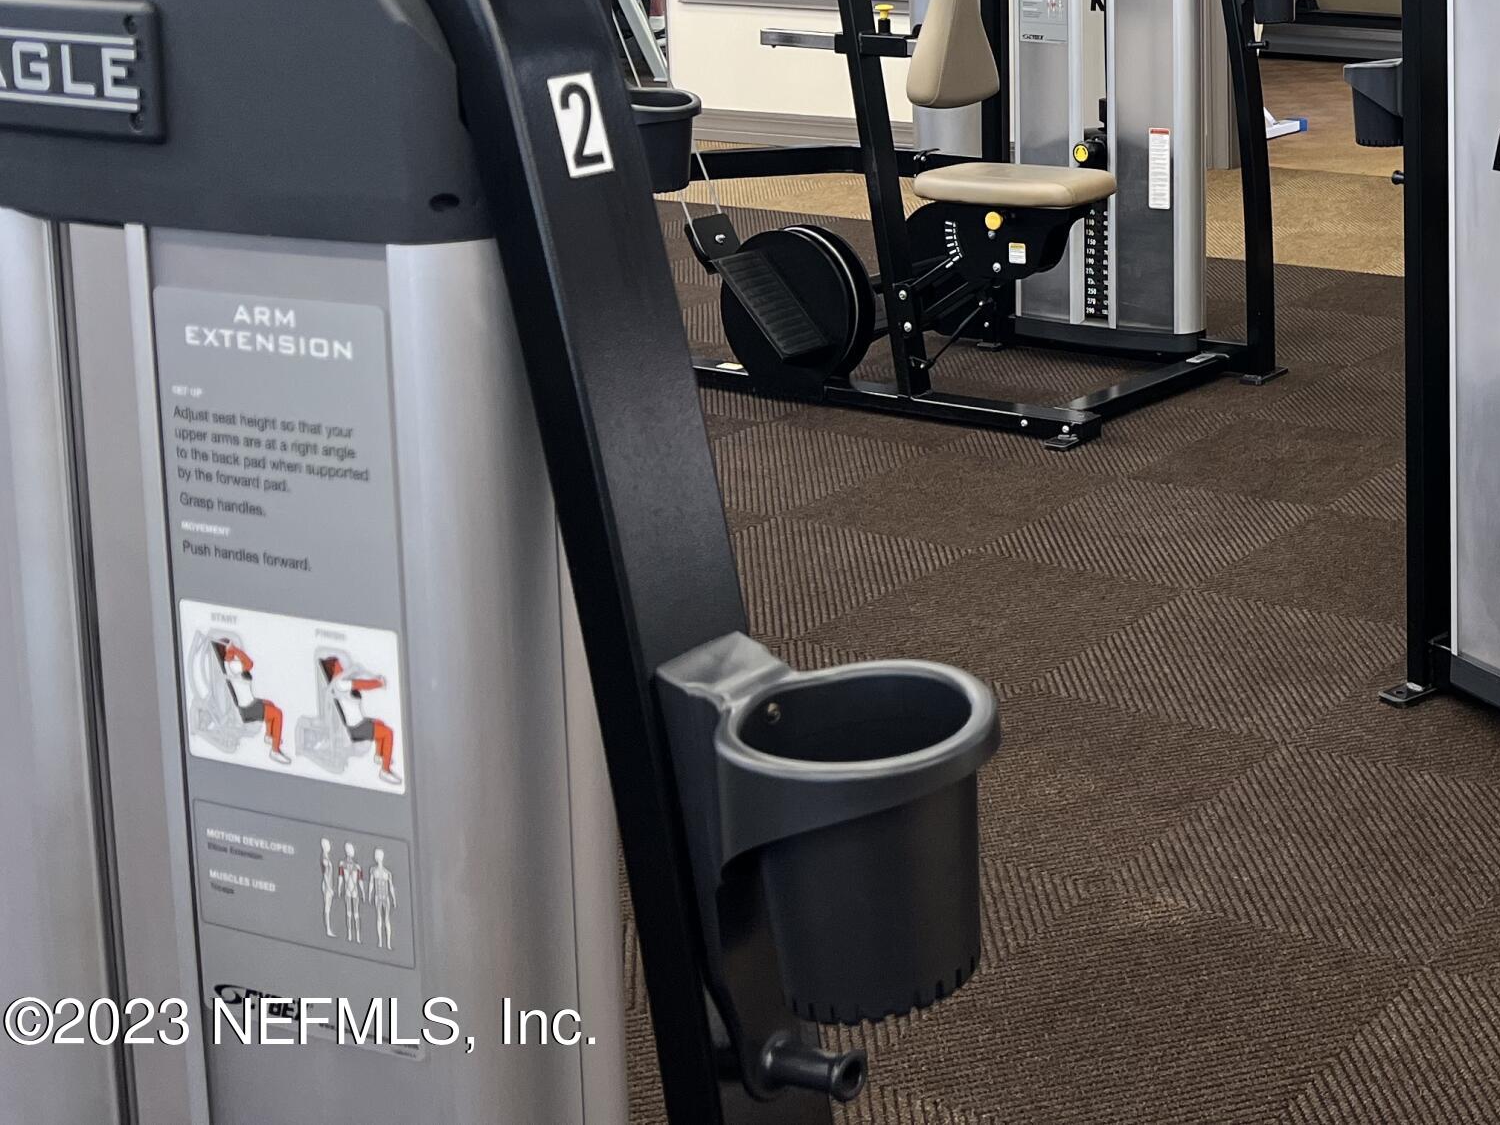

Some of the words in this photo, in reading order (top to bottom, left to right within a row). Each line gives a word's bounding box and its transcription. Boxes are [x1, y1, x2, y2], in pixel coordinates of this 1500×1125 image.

[0, 40, 139, 100] GLE
[560, 82, 606, 169] 2
[233, 305, 297, 328] ARM
[184, 325, 354, 360] EXTENSION
[173, 405, 209, 423] Adjust
[212, 412, 236, 424] seat
[240, 414, 276, 432] height
[280, 421, 295, 432] so
[299, 420, 322, 435] that
[326, 426, 354, 439] your
[175, 428, 208, 443] upper
[211, 432, 240, 446] arms
[242, 436, 262, 448] are
[265, 437, 277, 450] at
[290, 440, 319, 458] right
[321, 445, 356, 462] angle
[176, 446, 188, 459] to
[191, 448, 209, 462] the
[211, 450, 240, 466] back
[243, 454, 267, 470] pad
[269, 459, 302, 474] when
[305, 463, 370, 482] supported
[177, 465, 191, 482] by
[195, 468, 213, 482] the
[216, 470, 259, 490] forward
[263, 476, 290, 493] pad.
[179, 491, 214, 511] Grasp
[217, 497, 266, 517] handles.
[182, 539, 211, 558] Push
[214, 544, 259, 564] handles
[263, 552, 312, 572] forward.
[211, 612, 238, 625] START
[206, 828, 241, 844] MOTION
[243, 835, 295, 855] DEVELOPED
[209, 868, 250, 887] MUSCLES
[252, 878, 276, 892] USED
